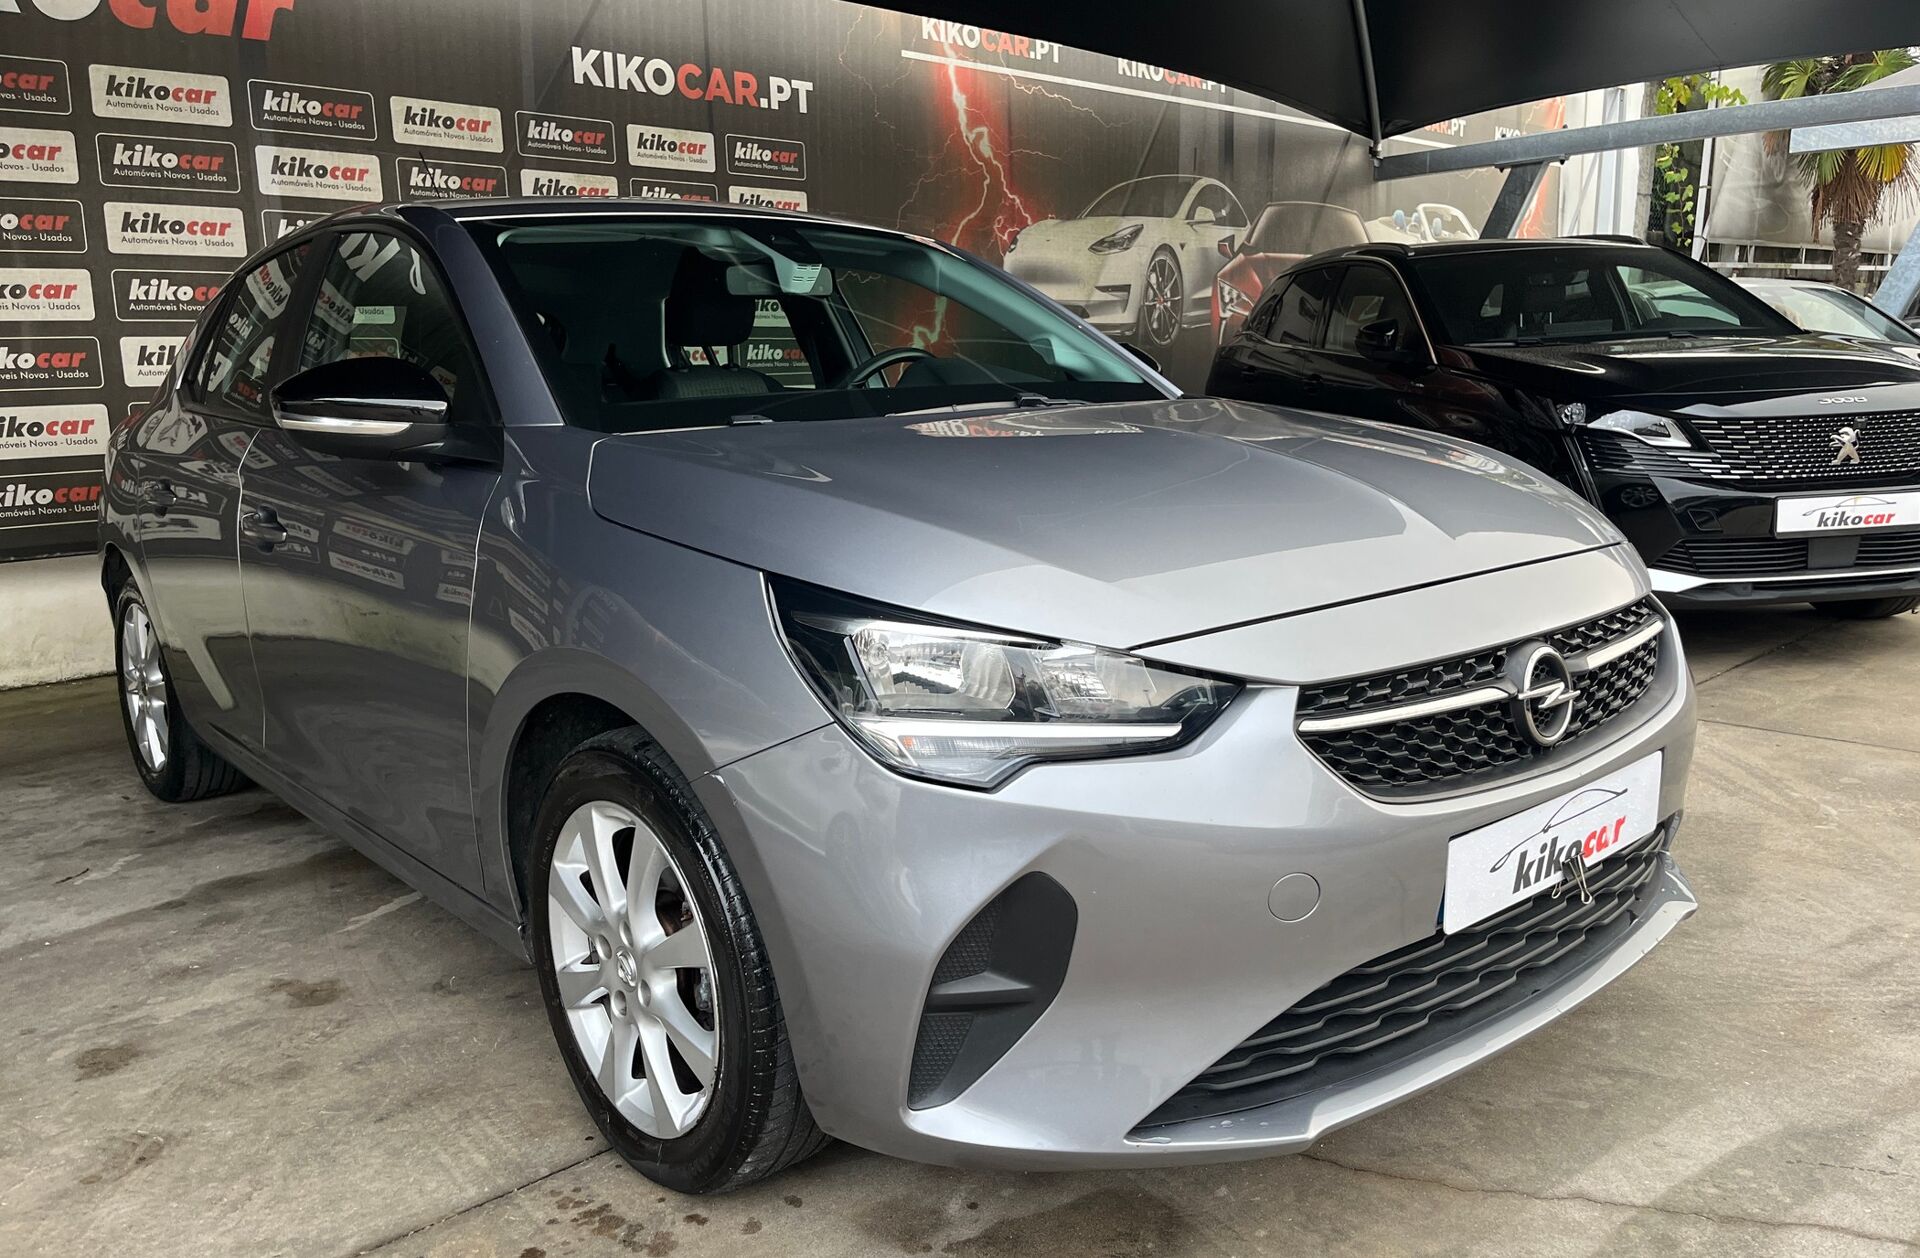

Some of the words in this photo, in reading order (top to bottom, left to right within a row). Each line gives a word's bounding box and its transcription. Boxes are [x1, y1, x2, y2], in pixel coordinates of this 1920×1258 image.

[0, 0, 296, 41] car
[921, 16, 1063, 63] KIKOCAR.PT
[0, 72, 54, 91] car
[571, 46, 814, 114] KIKOCAR.PT
[23, 92, 57, 102] Usados
[105, 75, 217, 104] kikocar
[106, 100, 154, 111] Automóveis
[156, 104, 183, 113] Novos
[190, 106, 220, 116] Usados
[263, 89, 363, 119] kikocar
[263, 113, 307, 124] Automóveis
[308, 117, 333, 127] Novos
[338, 120, 366, 130] Usados
[403, 106, 492, 133] kikocar
[404, 127, 442, 138] Automóveis
[444, 132, 465, 141] Novos
[527, 120, 606, 145] kikocar
[563, 144, 582, 152] Novos
[637, 132, 707, 156] kikocar
[734, 141, 798, 164] kikocar
[112, 143, 225, 171] kikocar
[0, 163, 24, 171] ovos
[31, 163, 64, 173] Usados
[113, 167, 162, 178] Automóveis
[163, 171, 190, 180] Novos
[197, 173, 227, 182] Usados
[271, 155, 369, 182] kikocar
[271, 178, 314, 188] Automóveis
[316, 181, 339, 190] Novos
[345, 183, 371, 192] Usados
[409, 166, 497, 192] kikocar
[533, 177, 609, 197] kikocar
[0, 213, 70, 231] ocar
[121, 212, 231, 237] kikocar
[2, 232, 32, 241] Novos
[39, 232, 73, 242] Usados
[121, 236, 169, 246] Automóveis
[171, 236, 198, 246] Novos
[204, 238, 234, 248] Usados
[11, 302, 41, 310] Novos
[48, 302, 81, 310] Usados
[129, 303, 178, 312] Automóveis
[746, 344, 804, 361] kikoca
[20, 370, 49, 380] Novos
[56, 369, 90, 379] Usados
[29, 439, 58, 448] Novos
[65, 437, 98, 447] Usados
[38, 506, 68, 516] Novos
[1816, 511, 1896, 528] kikocar
[1511, 815, 1627, 895] kikocar
